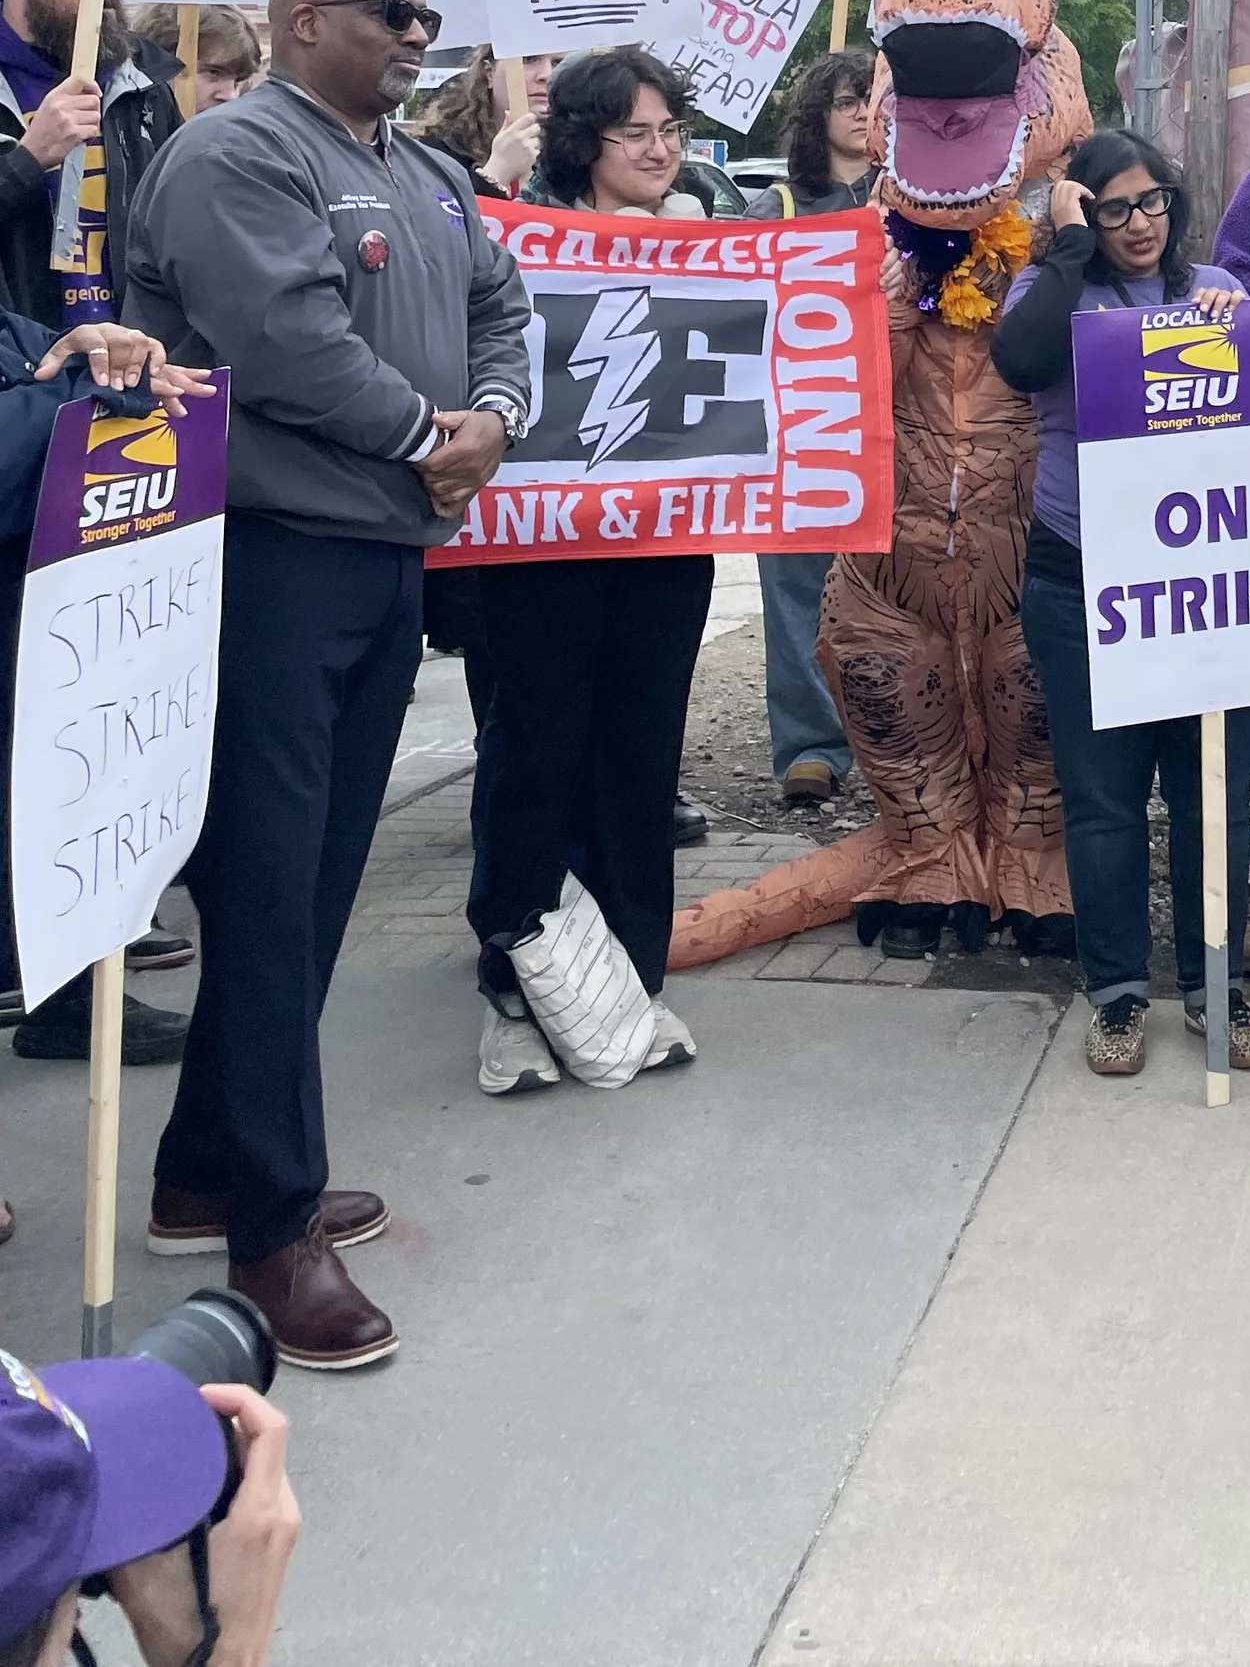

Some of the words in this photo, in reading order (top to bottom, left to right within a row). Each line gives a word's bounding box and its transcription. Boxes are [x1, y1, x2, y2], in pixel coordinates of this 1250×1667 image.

[1141, 310, 1205, 330] LOCAL
[1211, 308, 1233, 324] 3
[776, 229, 865, 534] UNION
[1144, 375, 1240, 414] SEIU
[1147, 418, 1193, 430] Stronger
[1196, 412, 1242, 426] Together
[78, 467, 178, 527] SEIU
[598, 488, 639, 540] &
[656, 482, 775, 539] FILE
[1155, 485, 1248, 548] ON
[80, 522, 130, 544] Stronger
[132, 508, 177, 533] Together
